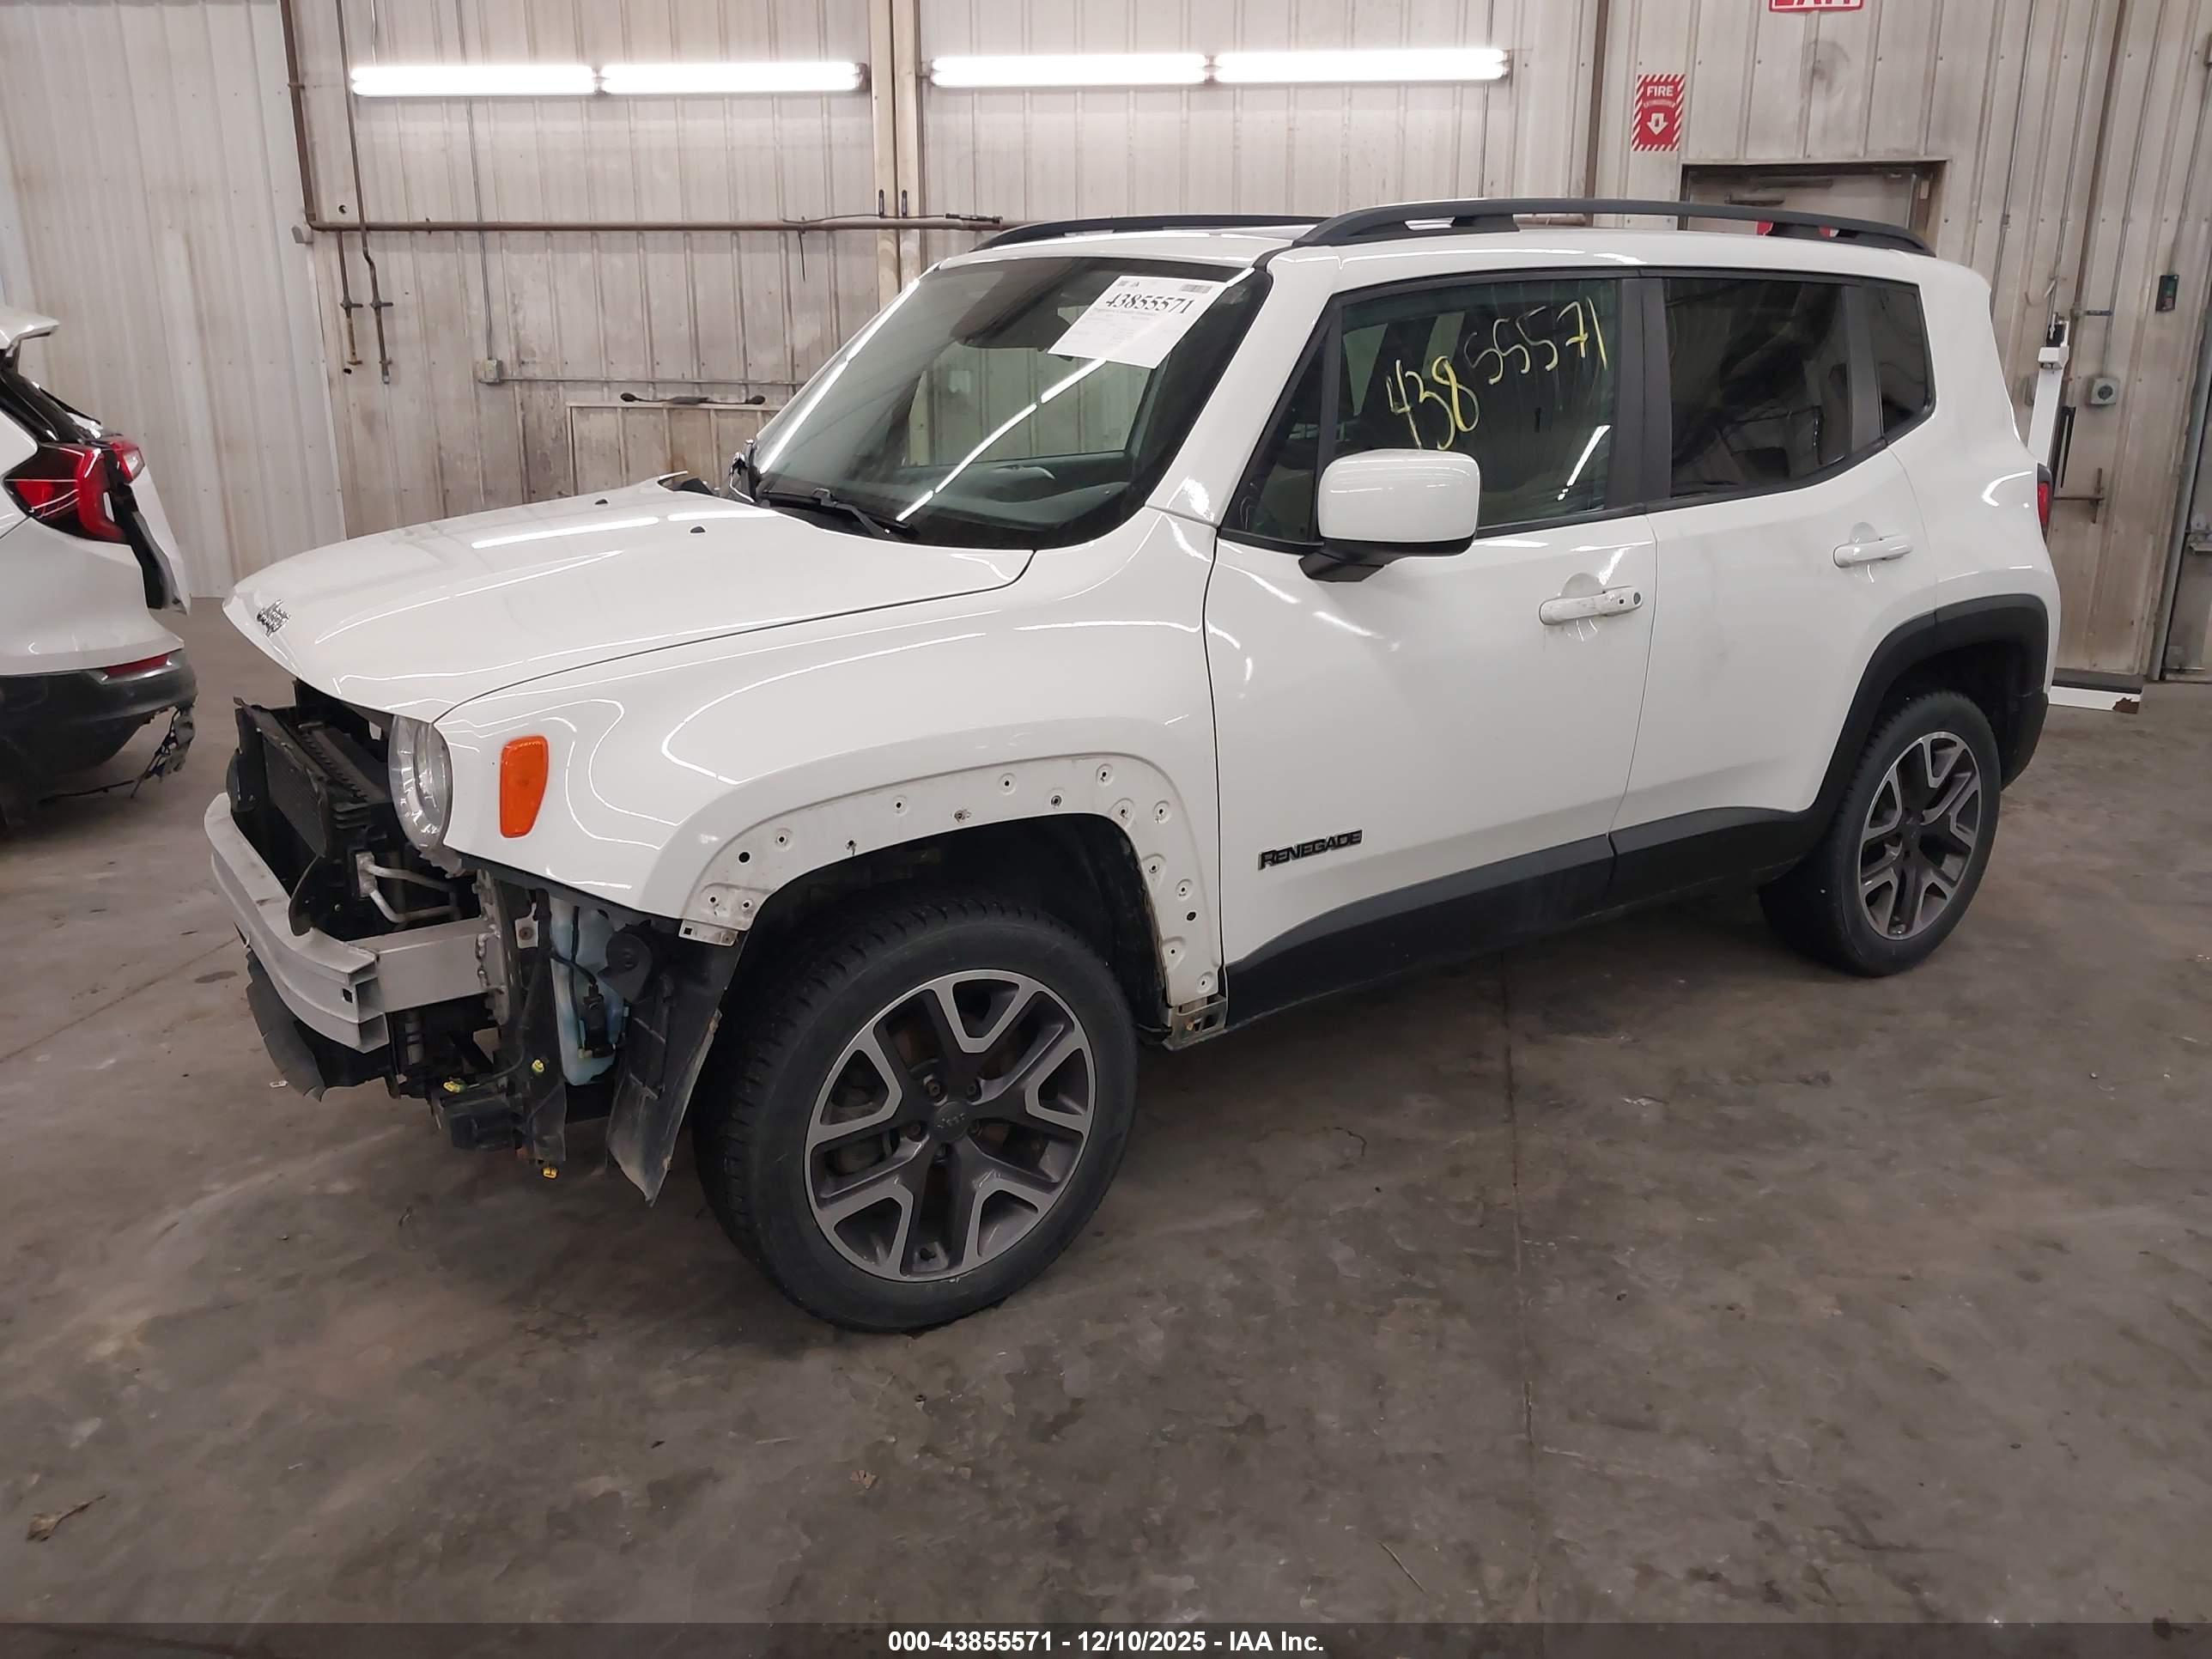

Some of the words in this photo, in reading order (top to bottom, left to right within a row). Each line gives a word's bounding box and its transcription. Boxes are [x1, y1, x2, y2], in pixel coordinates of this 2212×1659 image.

[1646, 85, 1674, 97] FIRE
[1105, 293, 1194, 314] 43855571
[1258, 830, 1363, 871] RENEGADE
